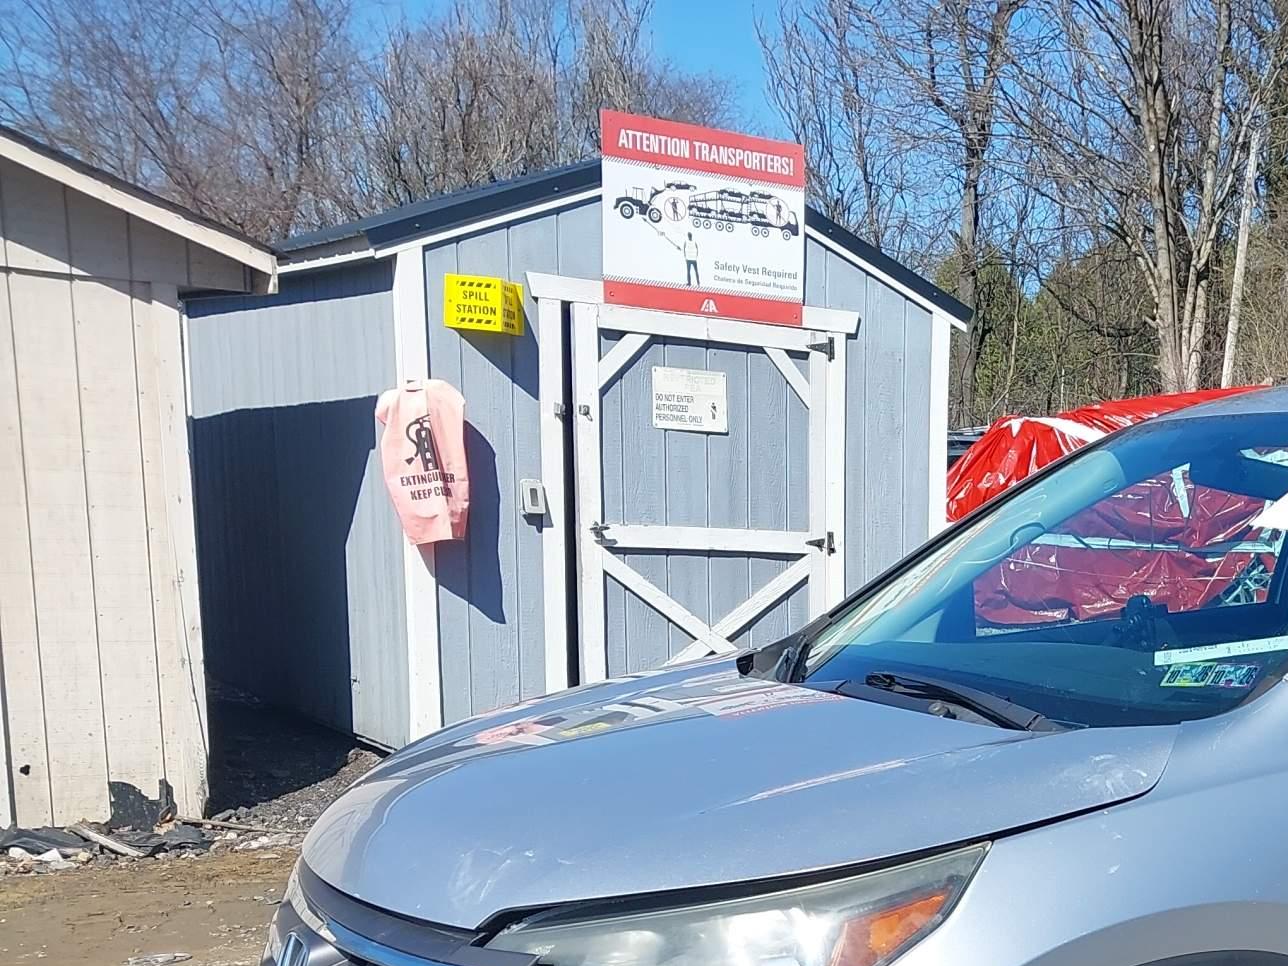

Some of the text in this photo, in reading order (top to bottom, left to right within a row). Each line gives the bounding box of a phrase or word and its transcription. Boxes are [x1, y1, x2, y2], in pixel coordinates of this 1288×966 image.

[618, 129, 794, 176] ATTENTION TRANSPORTERS!
[714, 261, 798, 280] Safety Vest Required
[463, 290, 490, 301] SPILL
[456, 304, 496, 316] STATION
[656, 393, 694, 403] DO NOT ENTER
[656, 403, 688, 412] AUTHORIZED
[688, 415, 703, 424] ONLY
[410, 488, 432, 501] KEEP
[1167, 669, 1181, 684] 10
[1211, 670, 1226, 684] 10
